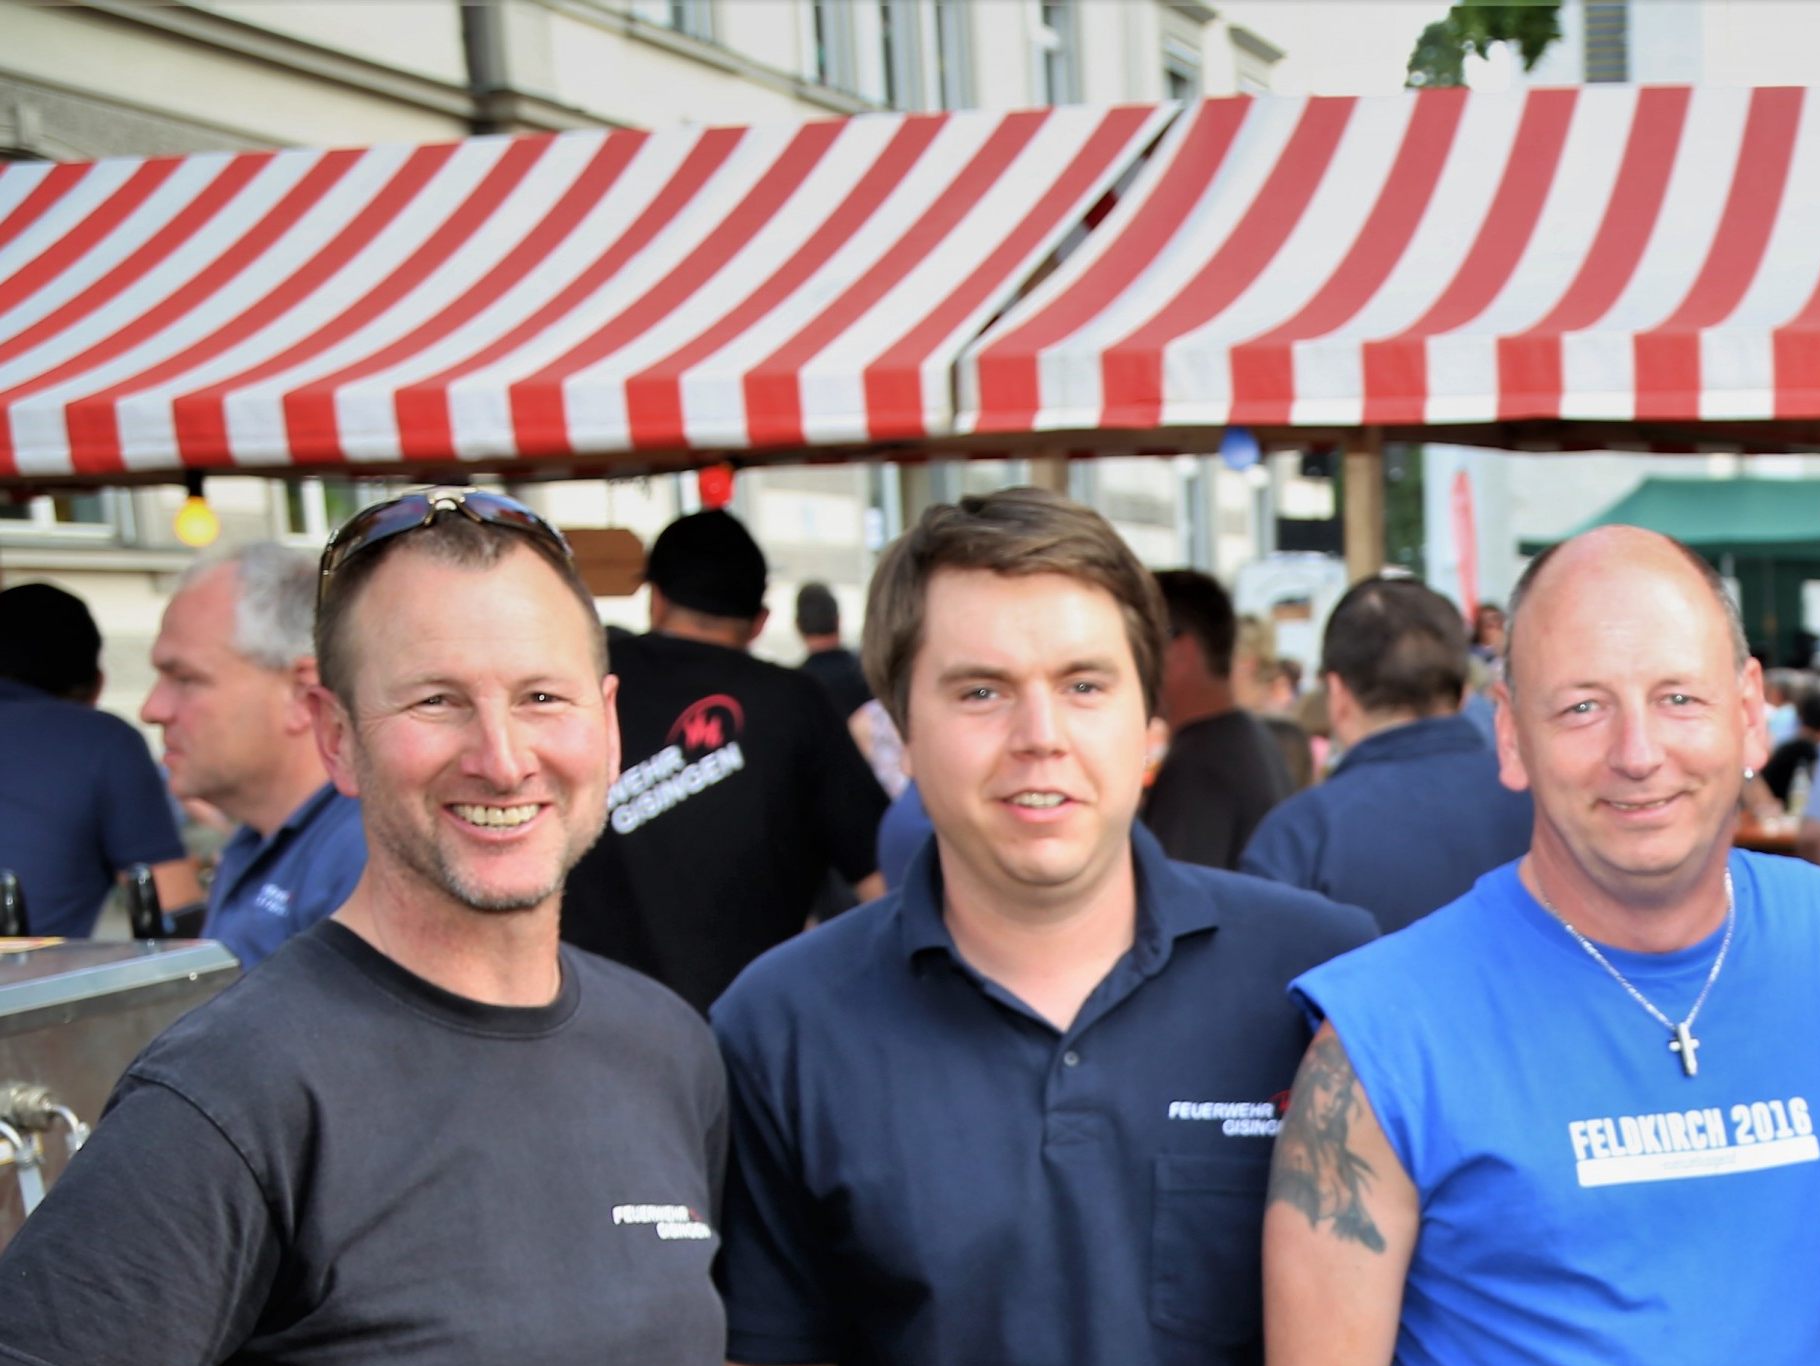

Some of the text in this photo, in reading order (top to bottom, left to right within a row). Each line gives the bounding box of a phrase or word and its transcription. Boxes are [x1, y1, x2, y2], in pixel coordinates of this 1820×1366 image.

[1168, 1101, 1275, 1120] FEUERWEHR
[1568, 1097, 1813, 1160] FELDKIRCH 2016
